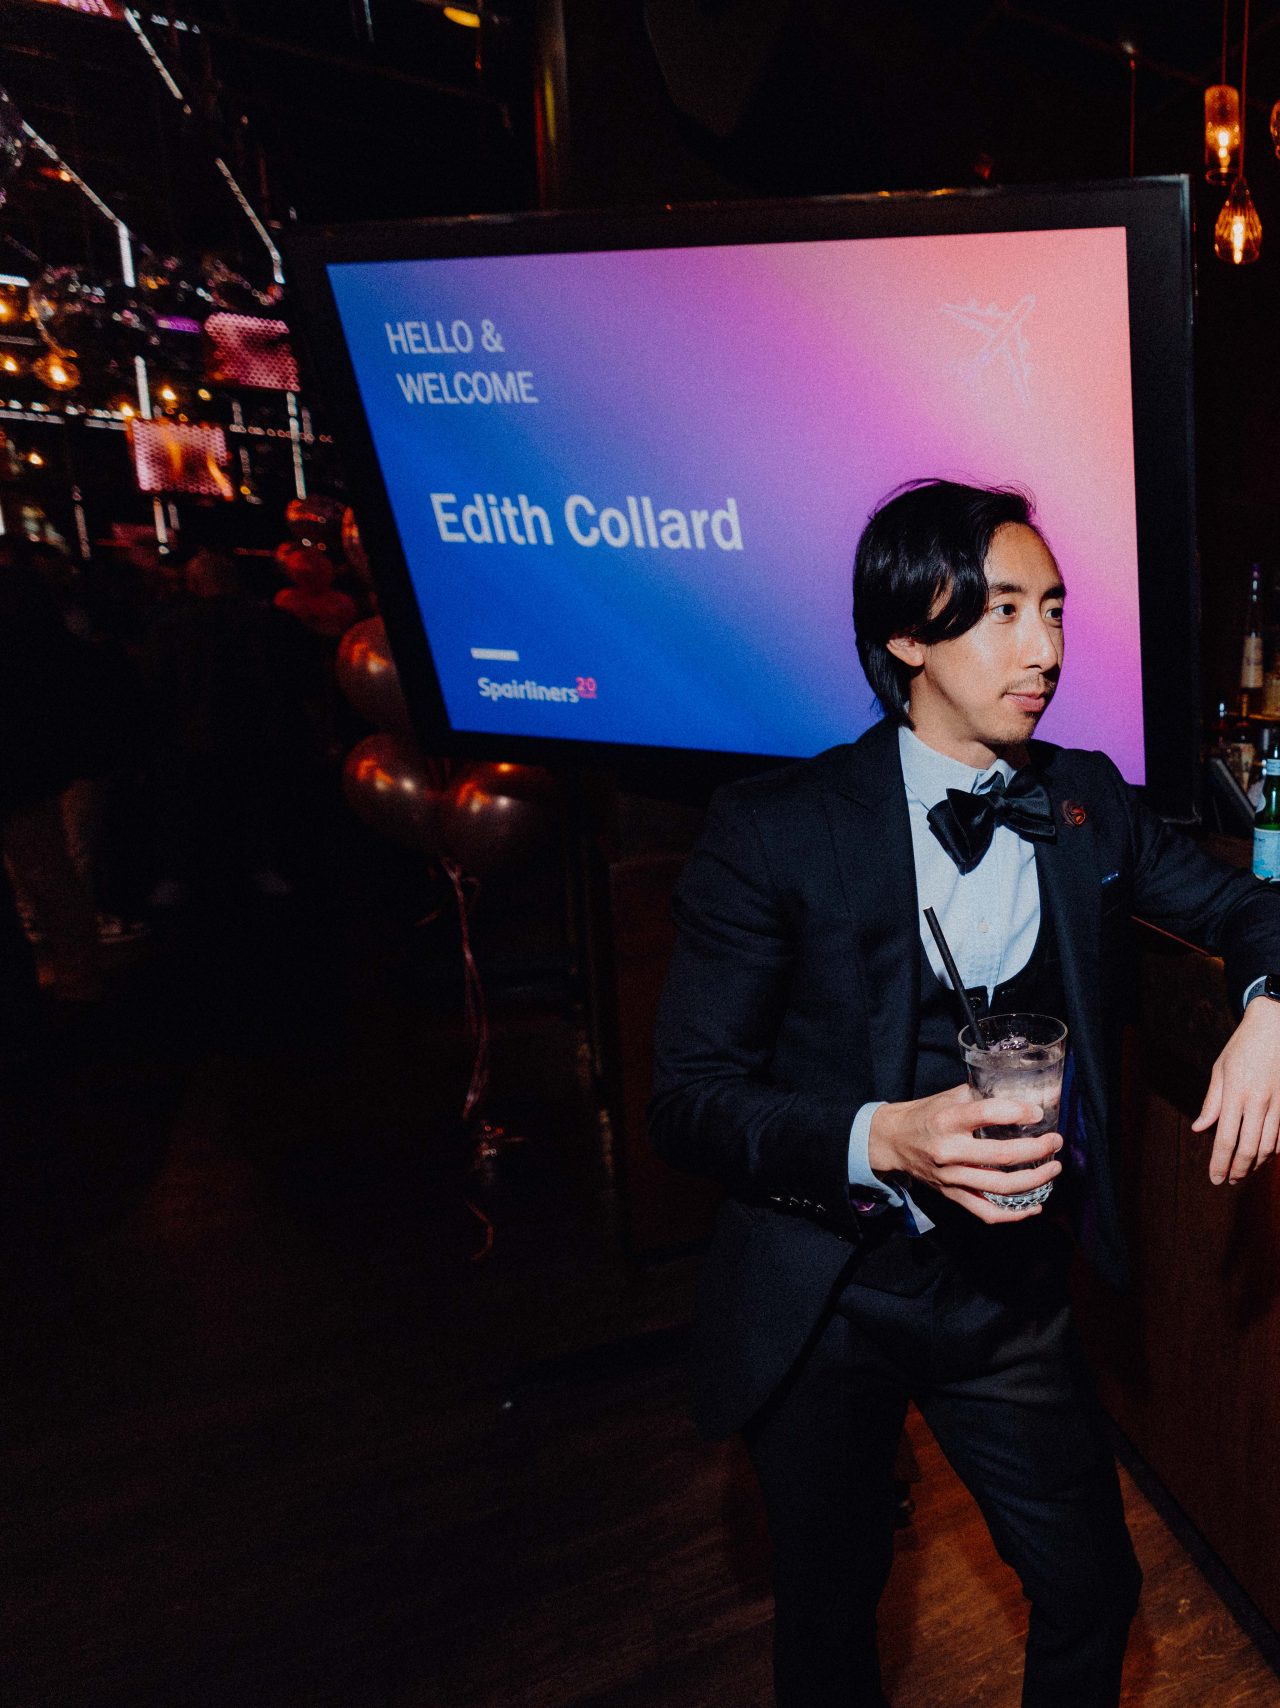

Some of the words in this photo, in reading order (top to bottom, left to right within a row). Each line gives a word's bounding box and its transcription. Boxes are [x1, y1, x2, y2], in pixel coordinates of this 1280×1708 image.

[385, 320, 473, 355] HELLO
[481, 319, 505, 354] &
[397, 371, 539, 405] WELCOME
[430, 492, 554, 546] Edith
[563, 494, 744, 551] Collard
[478, 677, 579, 703] Spairliners
